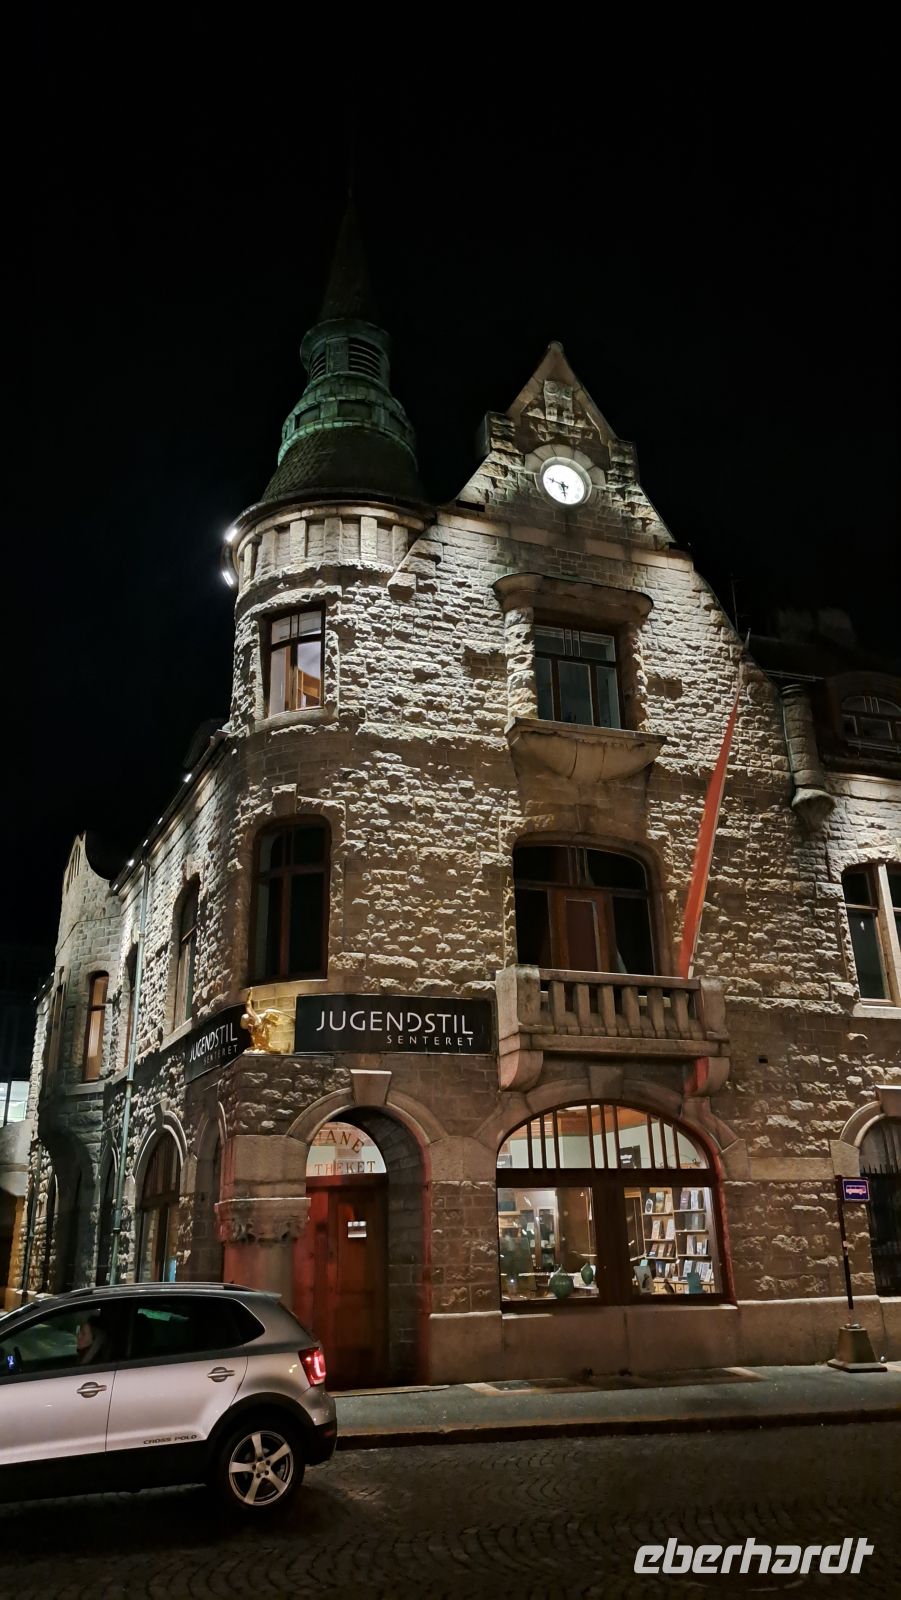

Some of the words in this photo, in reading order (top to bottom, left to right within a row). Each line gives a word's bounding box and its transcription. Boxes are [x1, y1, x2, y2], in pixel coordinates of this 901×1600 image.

[316, 1010, 474, 1035] JUGENDSTIL
[189, 1022, 238, 1062] JUGENDSTIL
[387, 1034, 474, 1047] SENTERET
